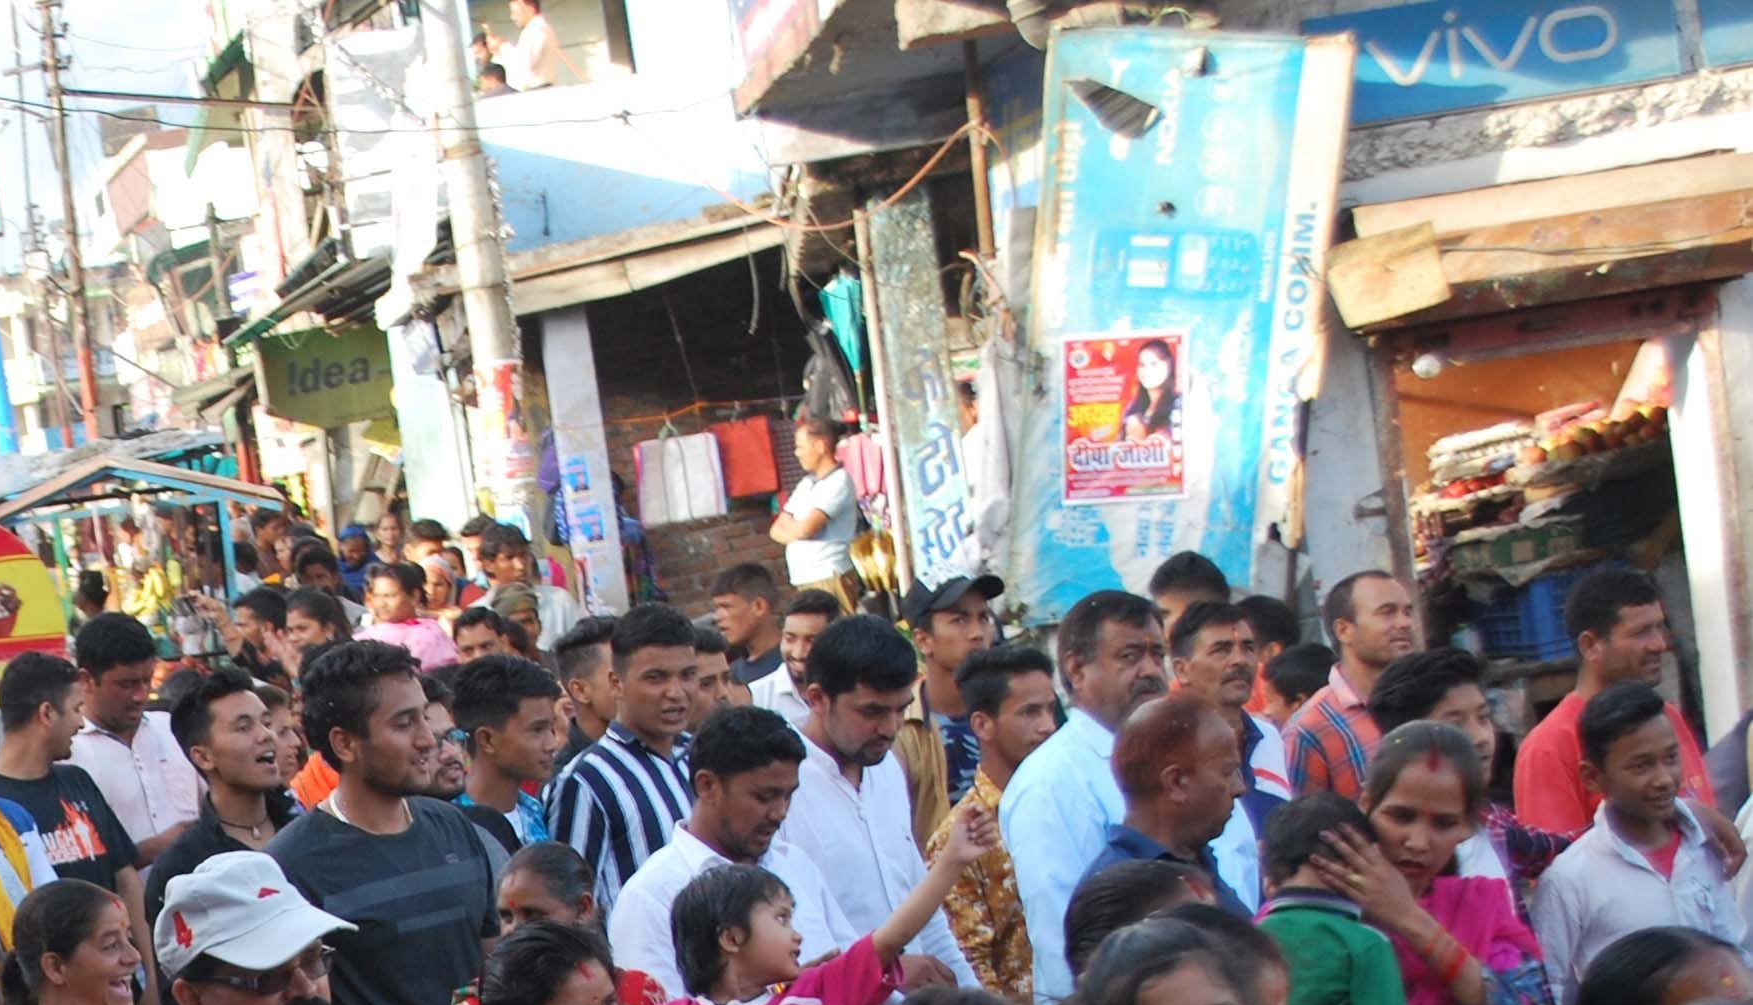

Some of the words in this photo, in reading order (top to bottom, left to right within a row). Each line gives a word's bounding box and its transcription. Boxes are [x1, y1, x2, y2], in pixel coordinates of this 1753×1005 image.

[1364, 5, 1618, 87] vivo
[1154, 68, 1183, 166] NOKIA
[1068, 438, 1112, 469] दीपा
[1115, 435, 1169, 467] जोशी
